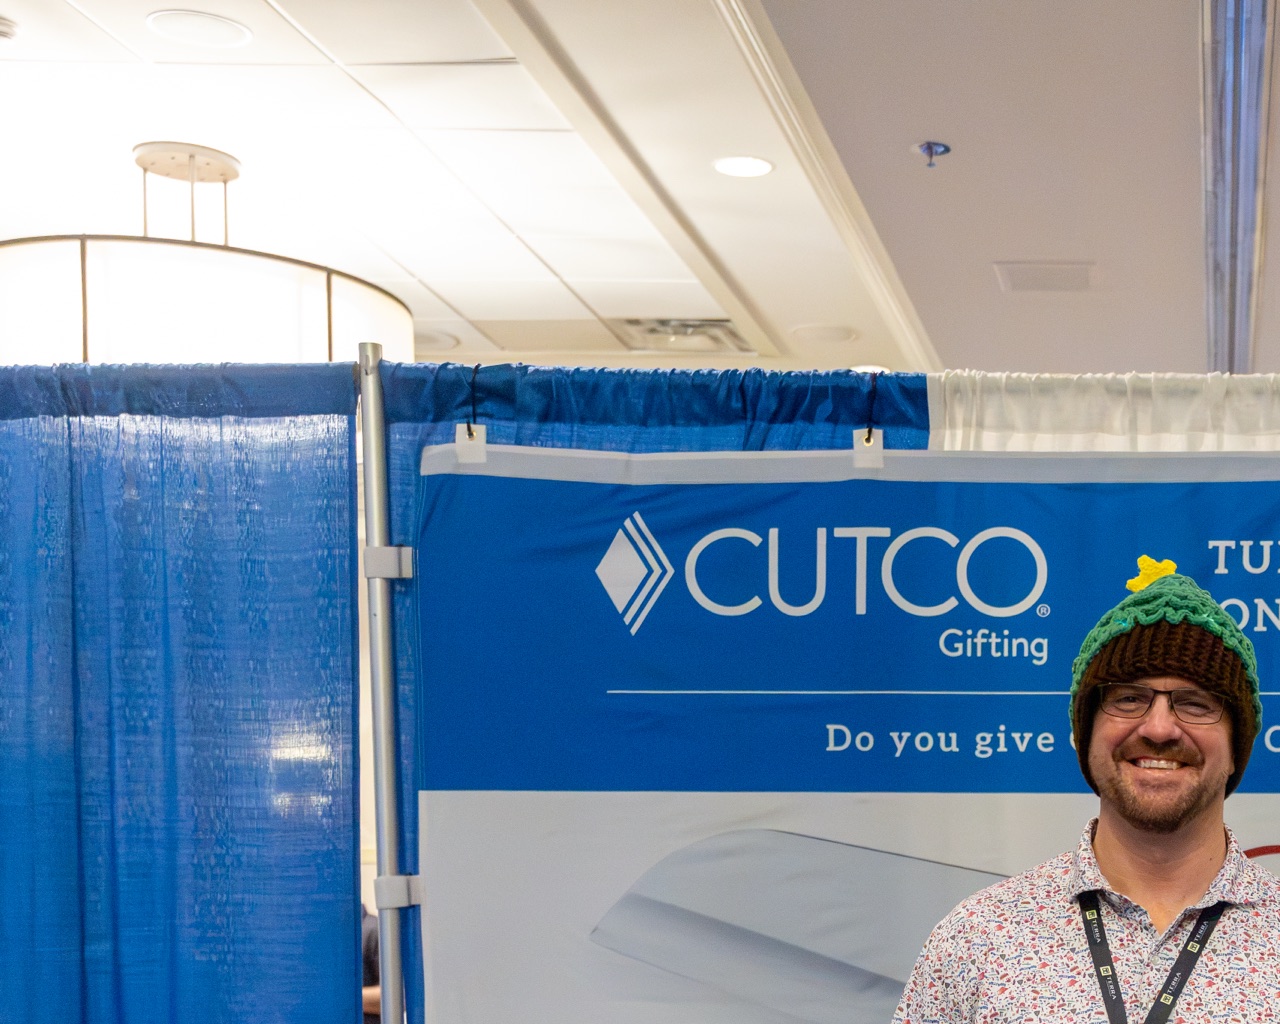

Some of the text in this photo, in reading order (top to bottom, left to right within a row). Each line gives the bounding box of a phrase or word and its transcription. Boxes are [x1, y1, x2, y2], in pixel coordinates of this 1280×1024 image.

[939, 629, 1049, 665] Gifting
[826, 724, 875, 752] Do
[890, 730, 960, 758] you
[974, 724, 1055, 759] give
[1167, 972, 1182, 994] TERRA
